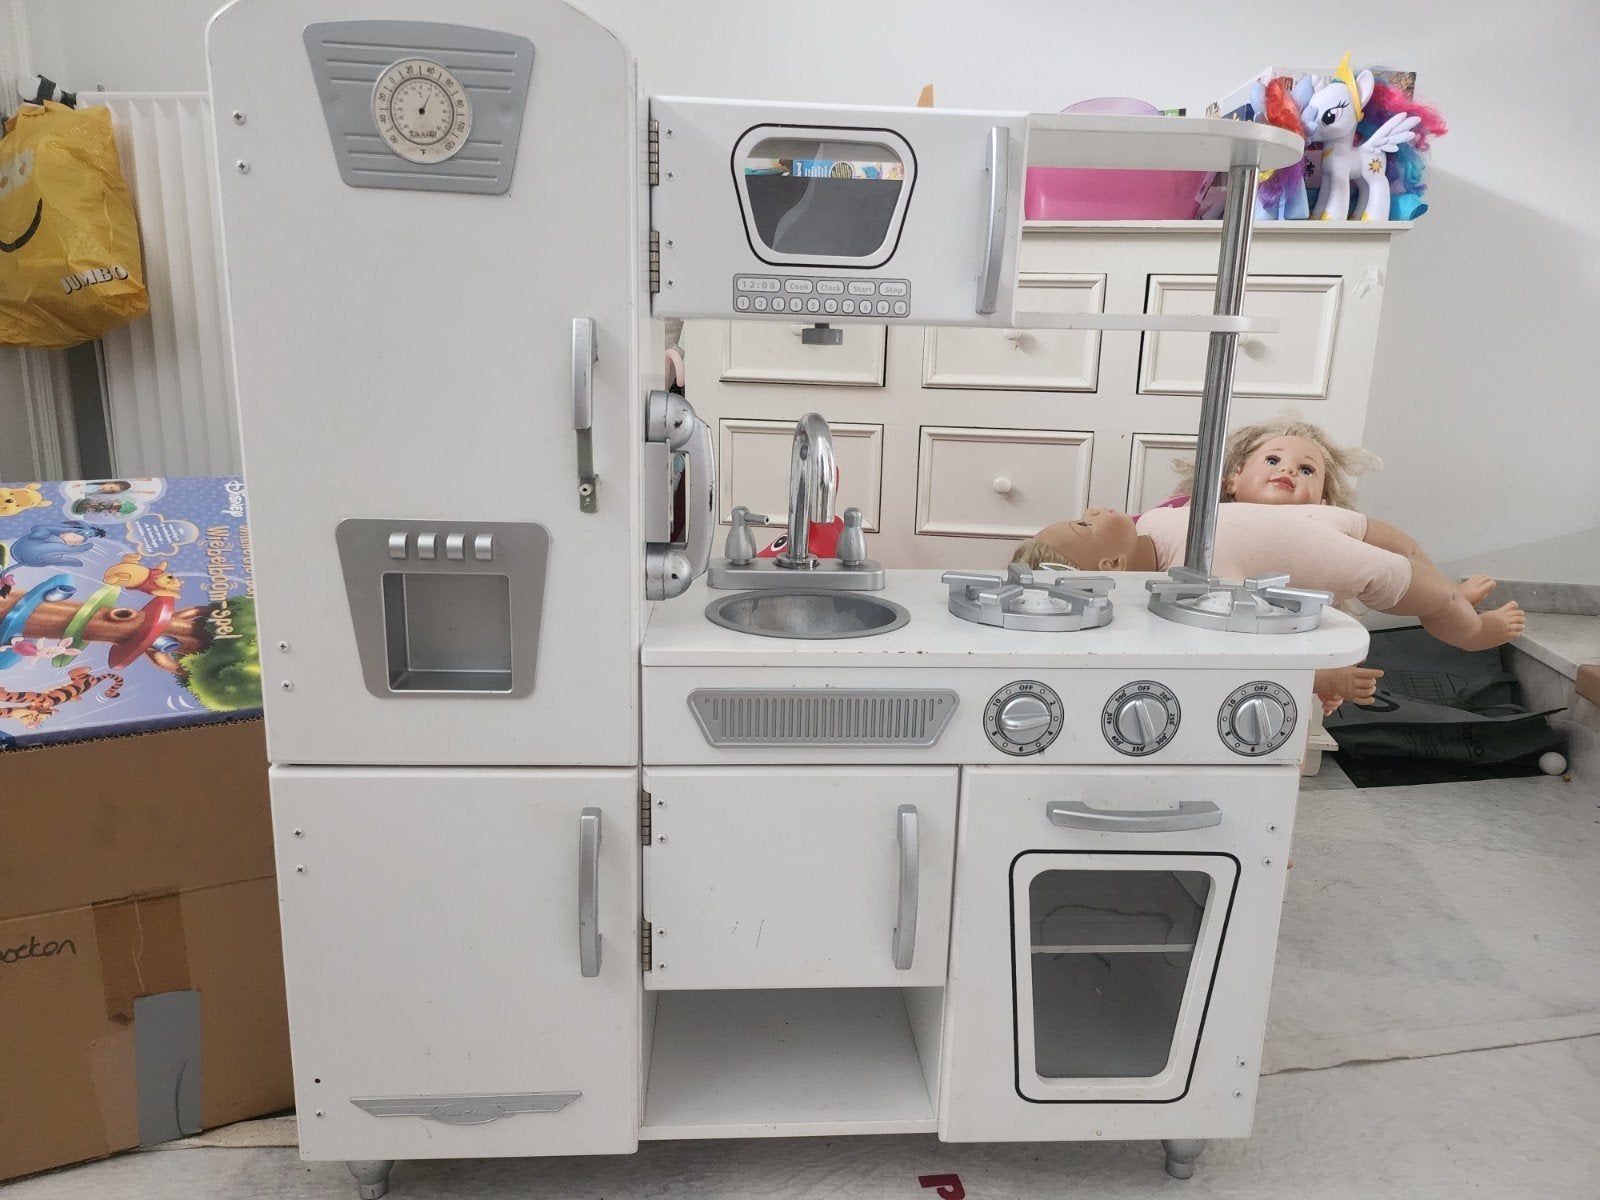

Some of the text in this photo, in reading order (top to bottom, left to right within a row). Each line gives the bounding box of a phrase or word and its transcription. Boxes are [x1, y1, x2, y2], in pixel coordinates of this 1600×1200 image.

[406, 66, 414, 74] 20
[61, 264, 128, 294] JUMBO
[820, 284, 842, 292] Clock
[852, 284, 872, 293] Start
[885, 286, 903, 295] Stop
[222, 480, 246, 518] Disney
